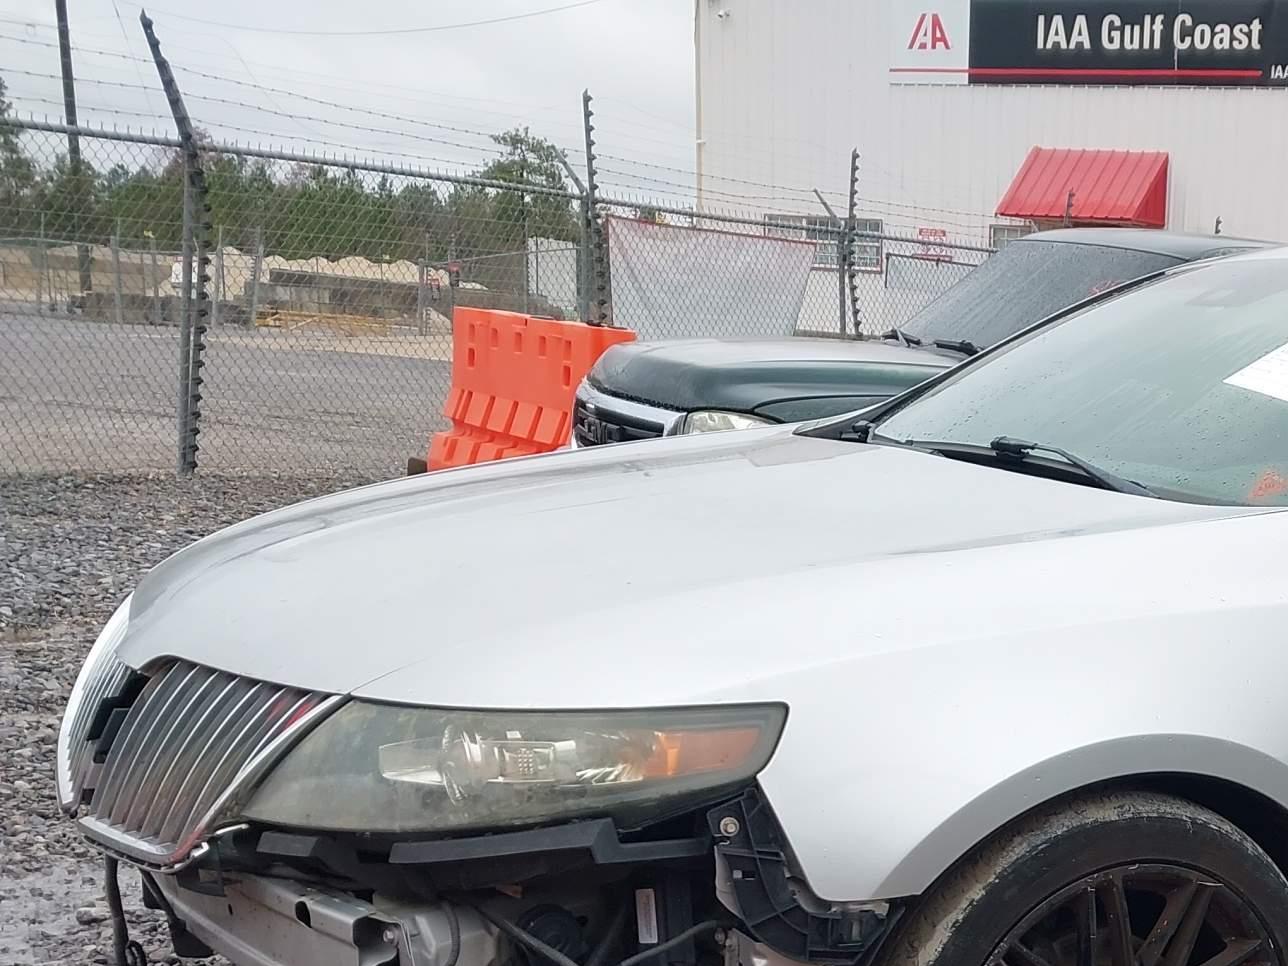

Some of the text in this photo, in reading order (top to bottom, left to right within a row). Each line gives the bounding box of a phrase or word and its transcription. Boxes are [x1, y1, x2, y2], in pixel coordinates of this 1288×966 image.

[1036, 13, 1263, 50] IAA Gulf Coast
